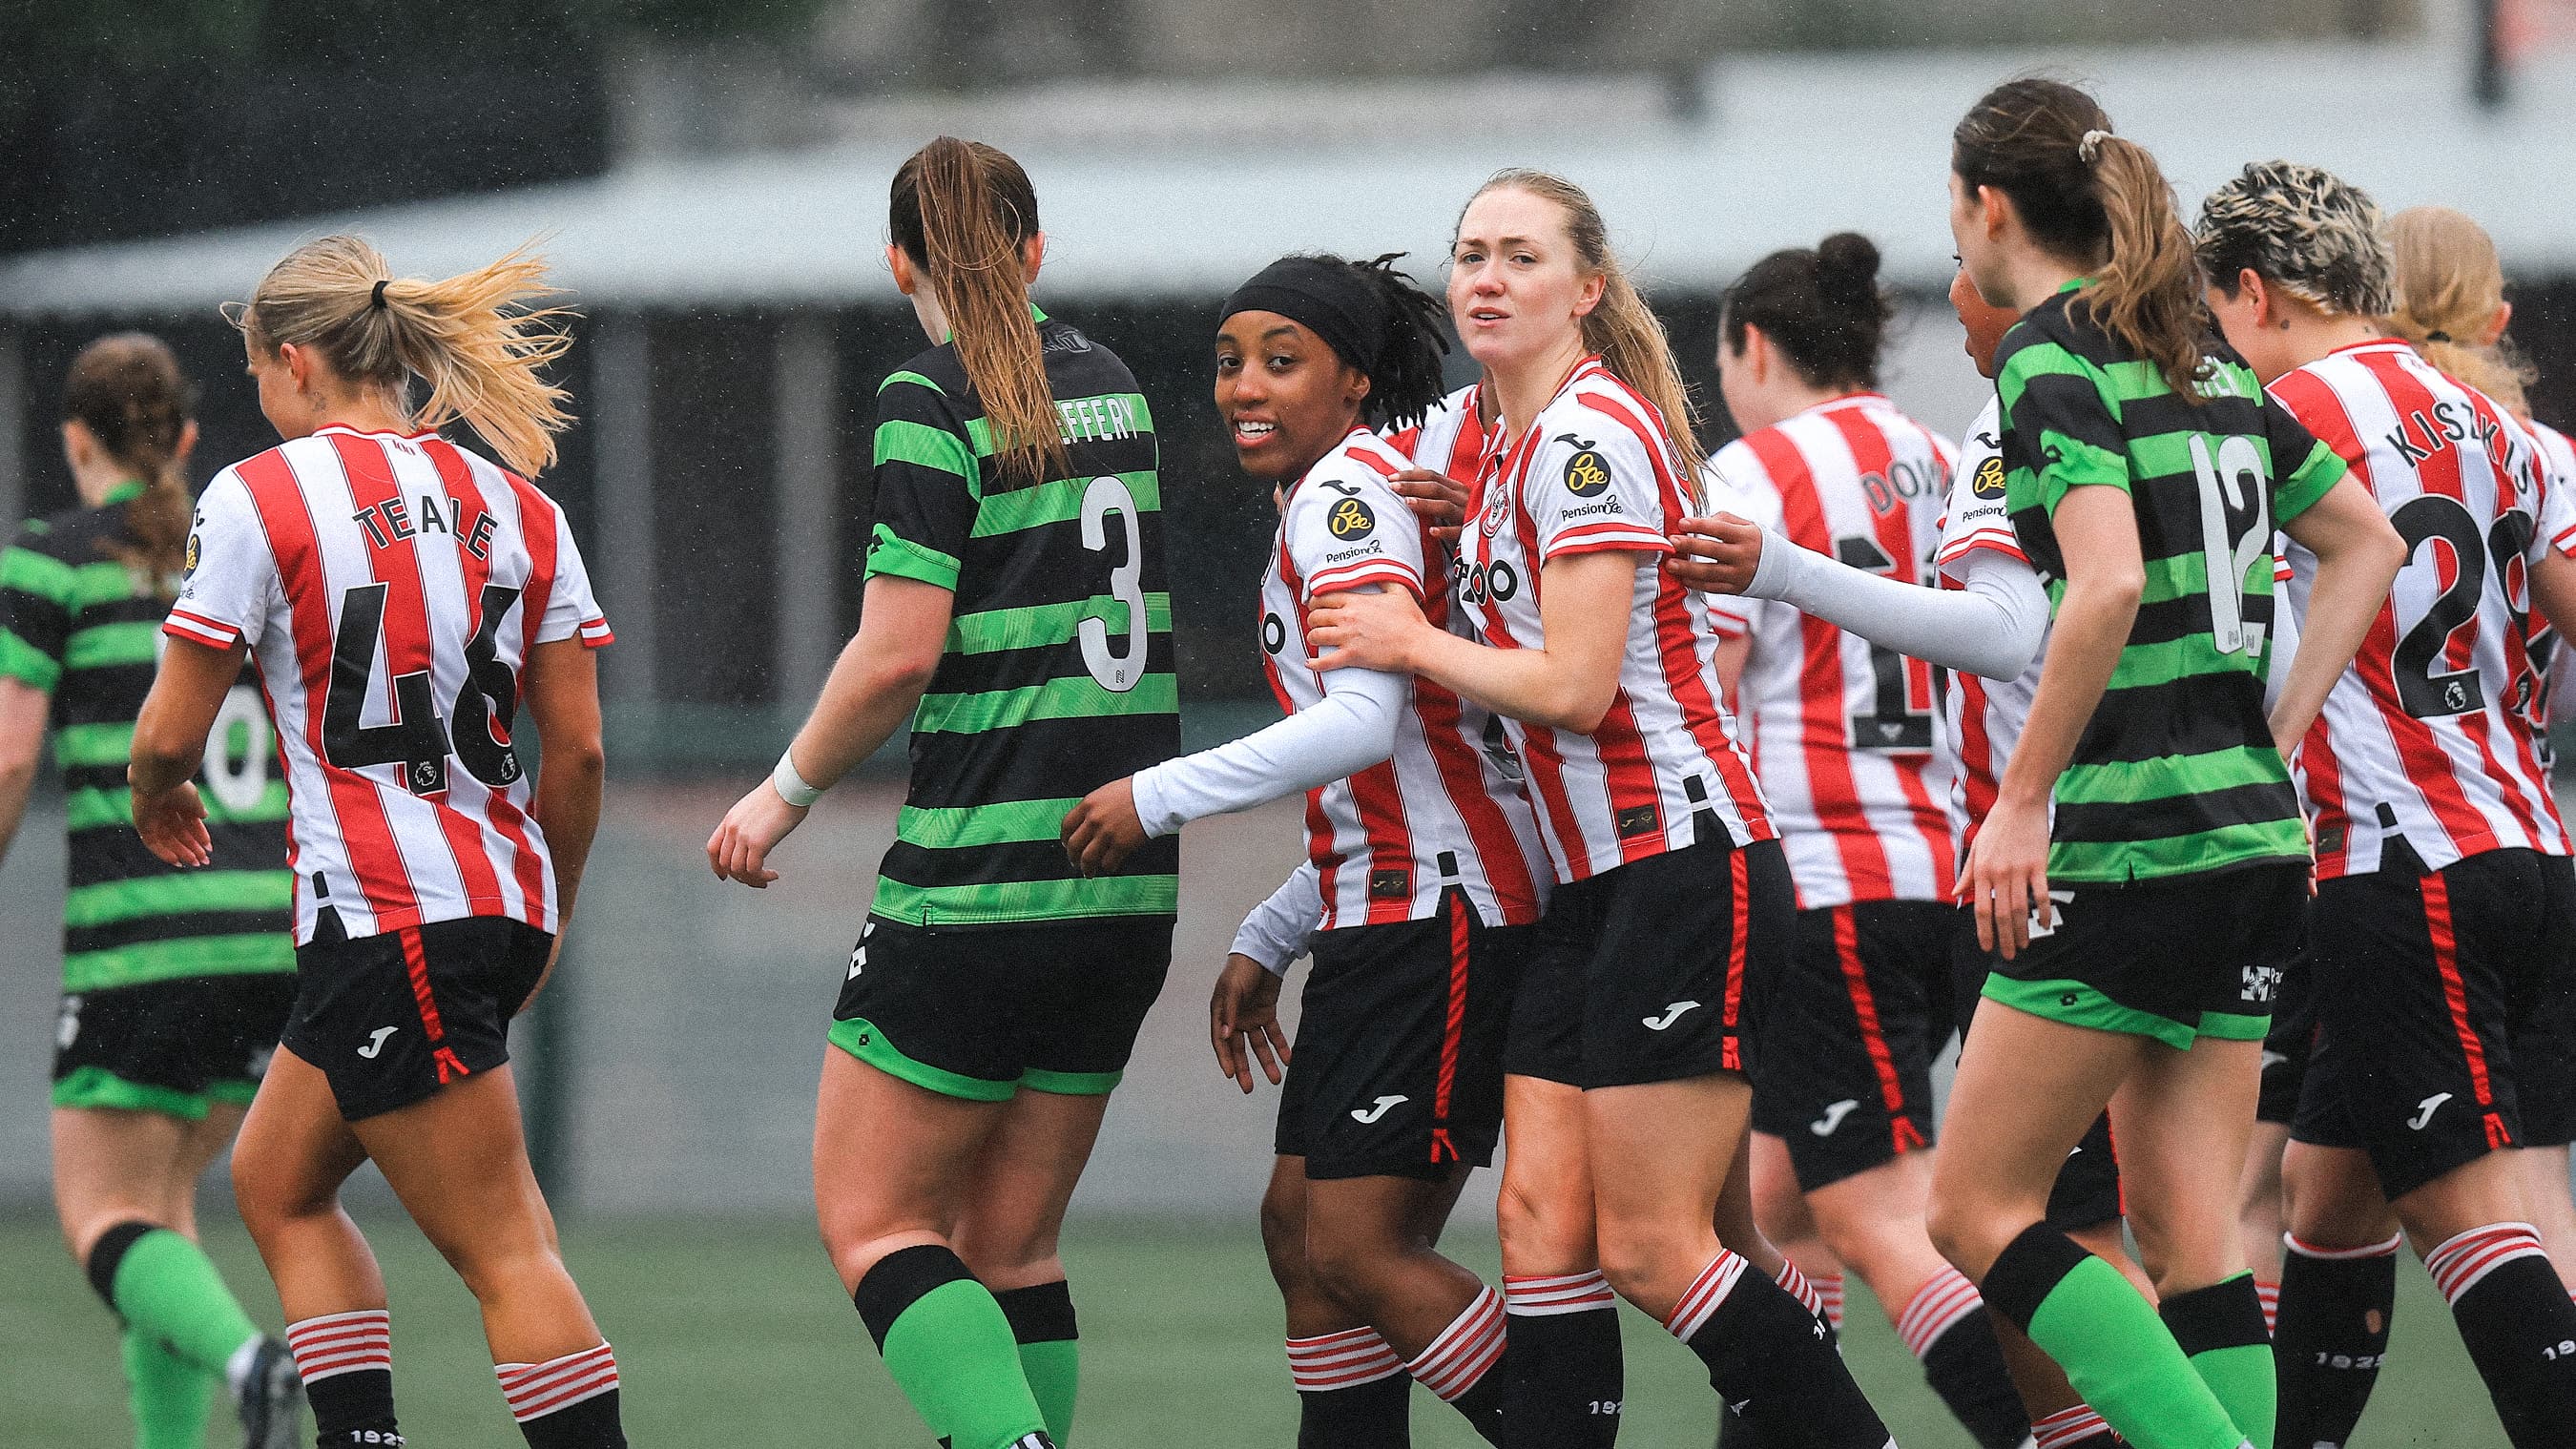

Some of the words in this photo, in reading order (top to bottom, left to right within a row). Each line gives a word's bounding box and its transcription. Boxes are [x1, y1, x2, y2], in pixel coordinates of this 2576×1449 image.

[352, 495, 499, 561] TEALE
[1332, 500, 1372, 534] Bee
[1568, 453, 1607, 490] Bee
[1077, 475, 1149, 693] 3
[2188, 432, 2271, 656] 12
[322, 582, 524, 796] 46
